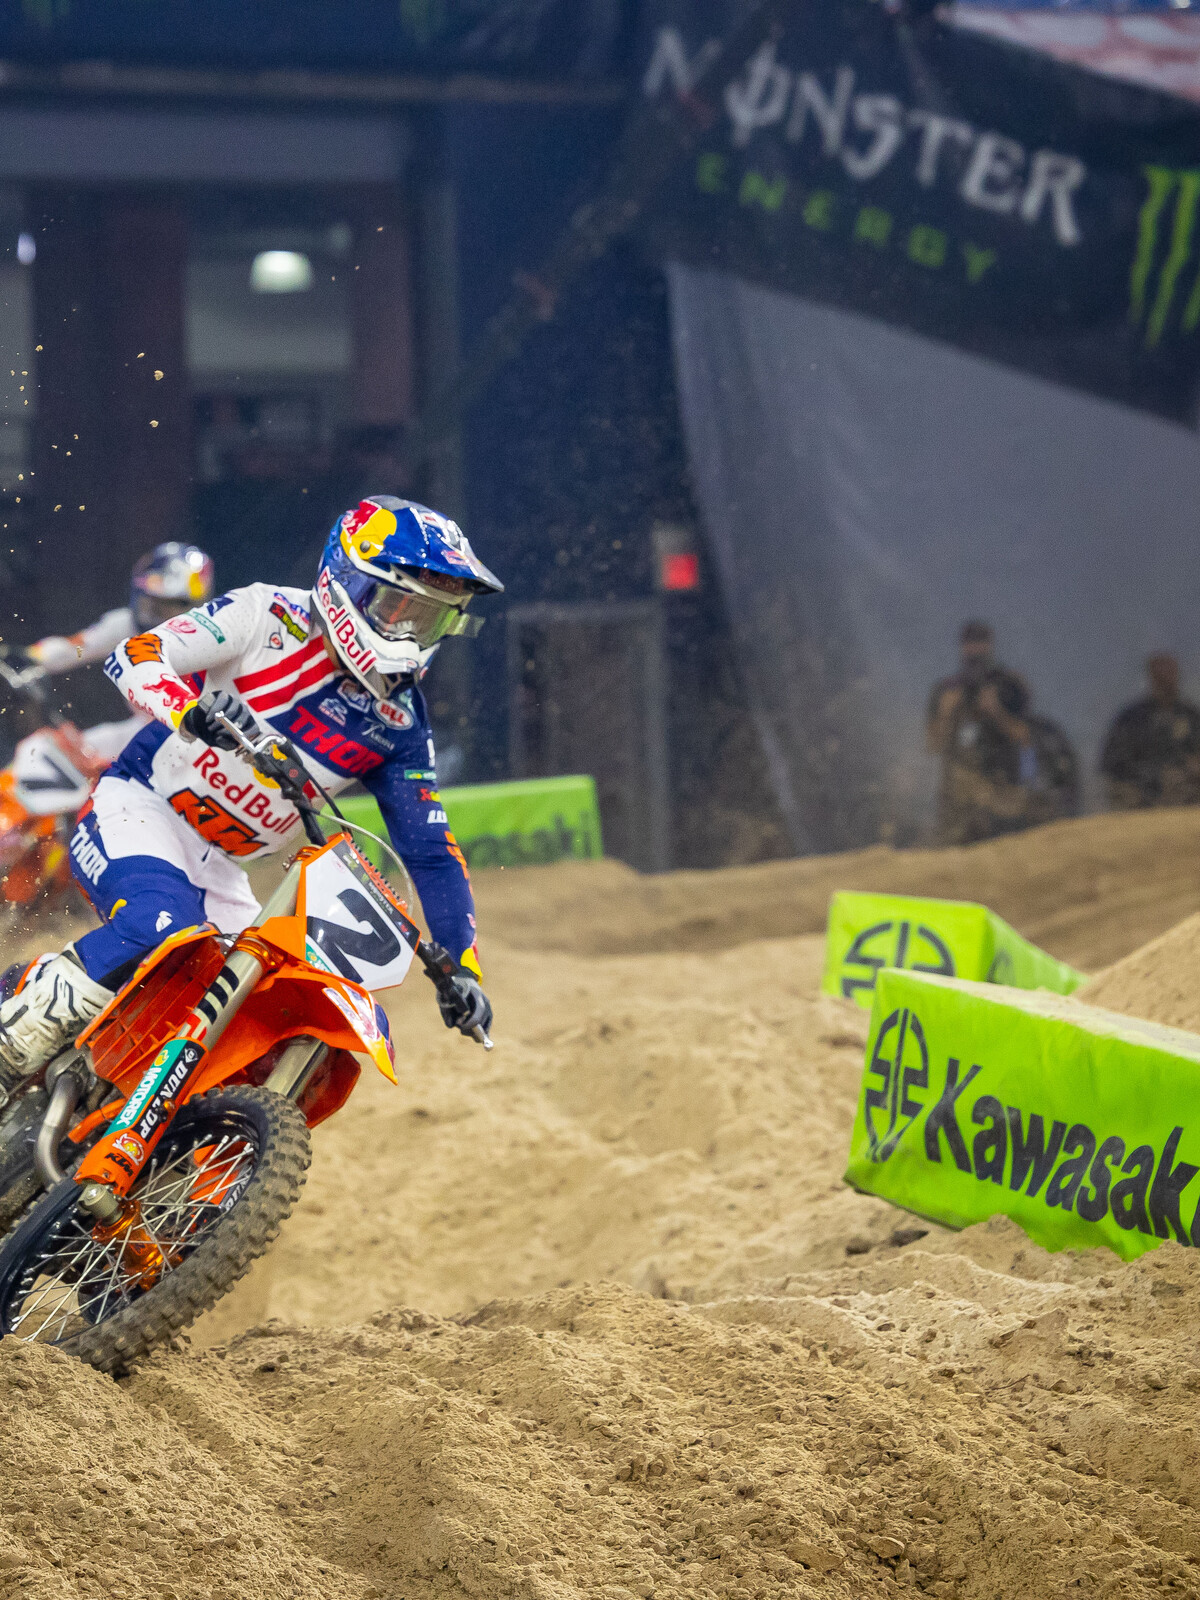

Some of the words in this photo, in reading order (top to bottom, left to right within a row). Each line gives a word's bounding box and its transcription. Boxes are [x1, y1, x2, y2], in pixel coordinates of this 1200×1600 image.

[317, 566, 346, 624] Red
[335, 618, 377, 673] Bull
[289, 705, 385, 775] THOR
[167, 787, 268, 857] KTM
[193, 747, 254, 805] Red
[242, 792, 300, 835] Bull
[70, 822, 109, 886] THOR
[306, 888, 401, 984] 2
[116, 1067, 162, 1127] MOTOREX
[140, 1060, 189, 1139] DUNLOP
[104, 1152, 134, 1178] KTM
